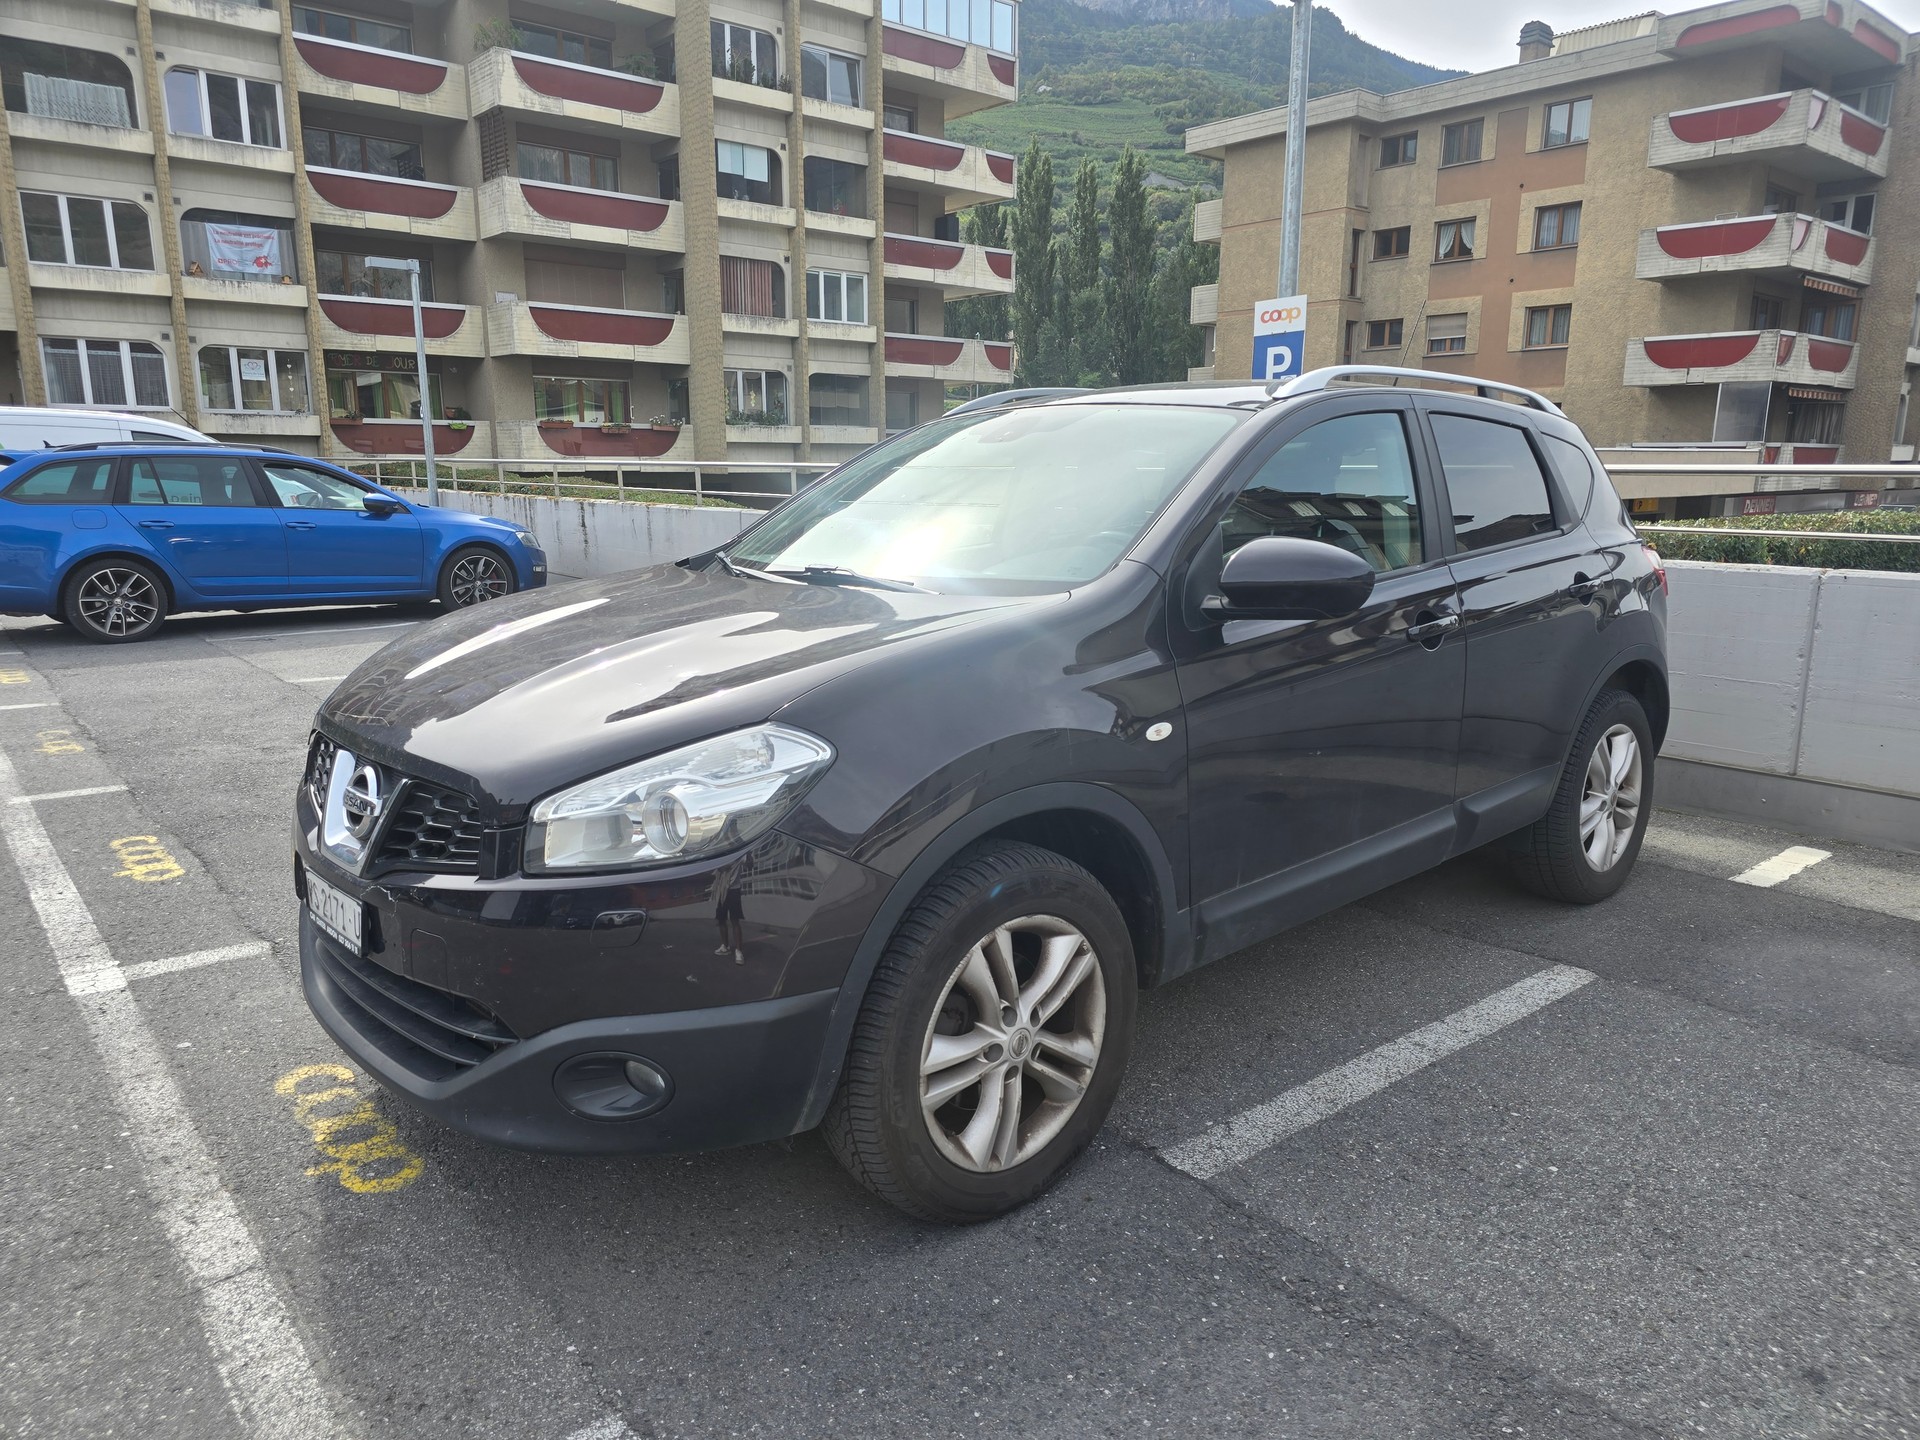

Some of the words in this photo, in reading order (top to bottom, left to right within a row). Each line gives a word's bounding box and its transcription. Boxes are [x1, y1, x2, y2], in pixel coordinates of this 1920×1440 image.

[1260, 307, 1302, 324] coop
[1265, 345, 1292, 380] P
[1743, 498, 1775, 513] DENNER
[108, 834, 186, 882] coop
[274, 1063, 426, 1193] coop
